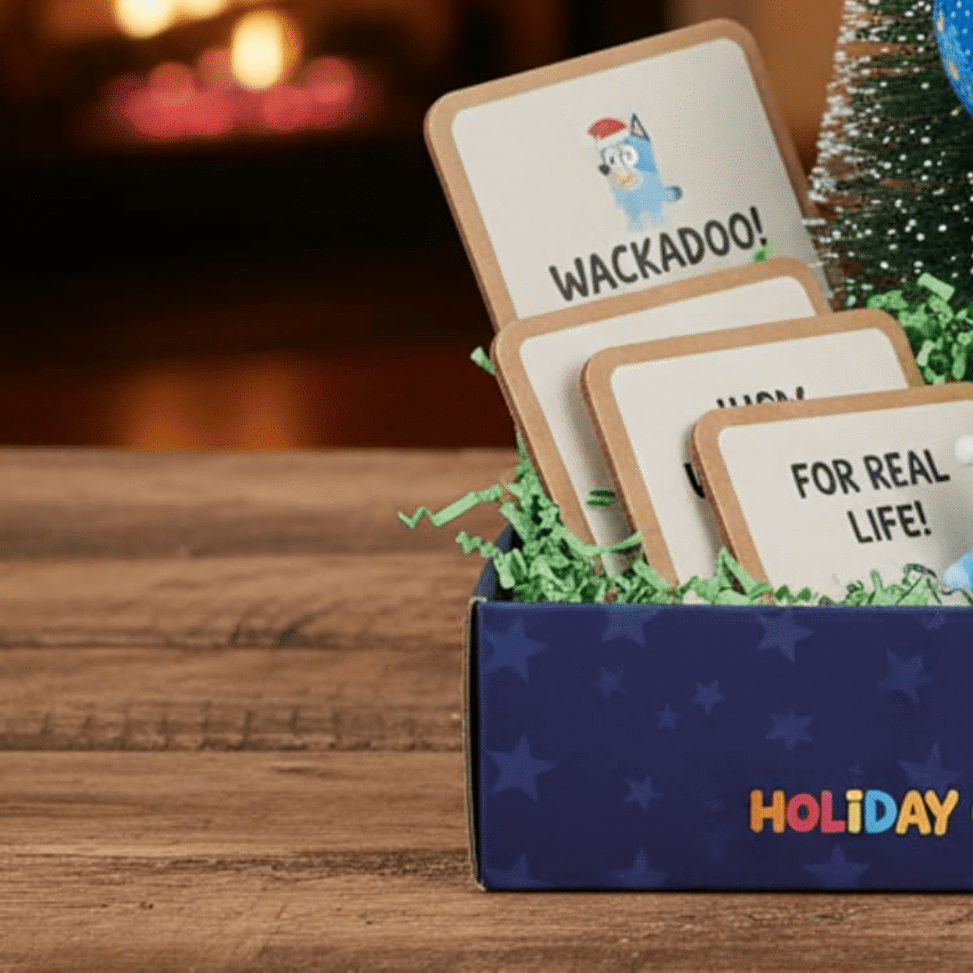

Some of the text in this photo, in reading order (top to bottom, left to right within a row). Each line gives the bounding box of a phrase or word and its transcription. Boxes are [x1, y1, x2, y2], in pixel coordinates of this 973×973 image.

[548, 206, 768, 301] WACKADOO!
[790, 448, 951, 499] FOR REAL
[846, 499, 932, 544] LIFE!
